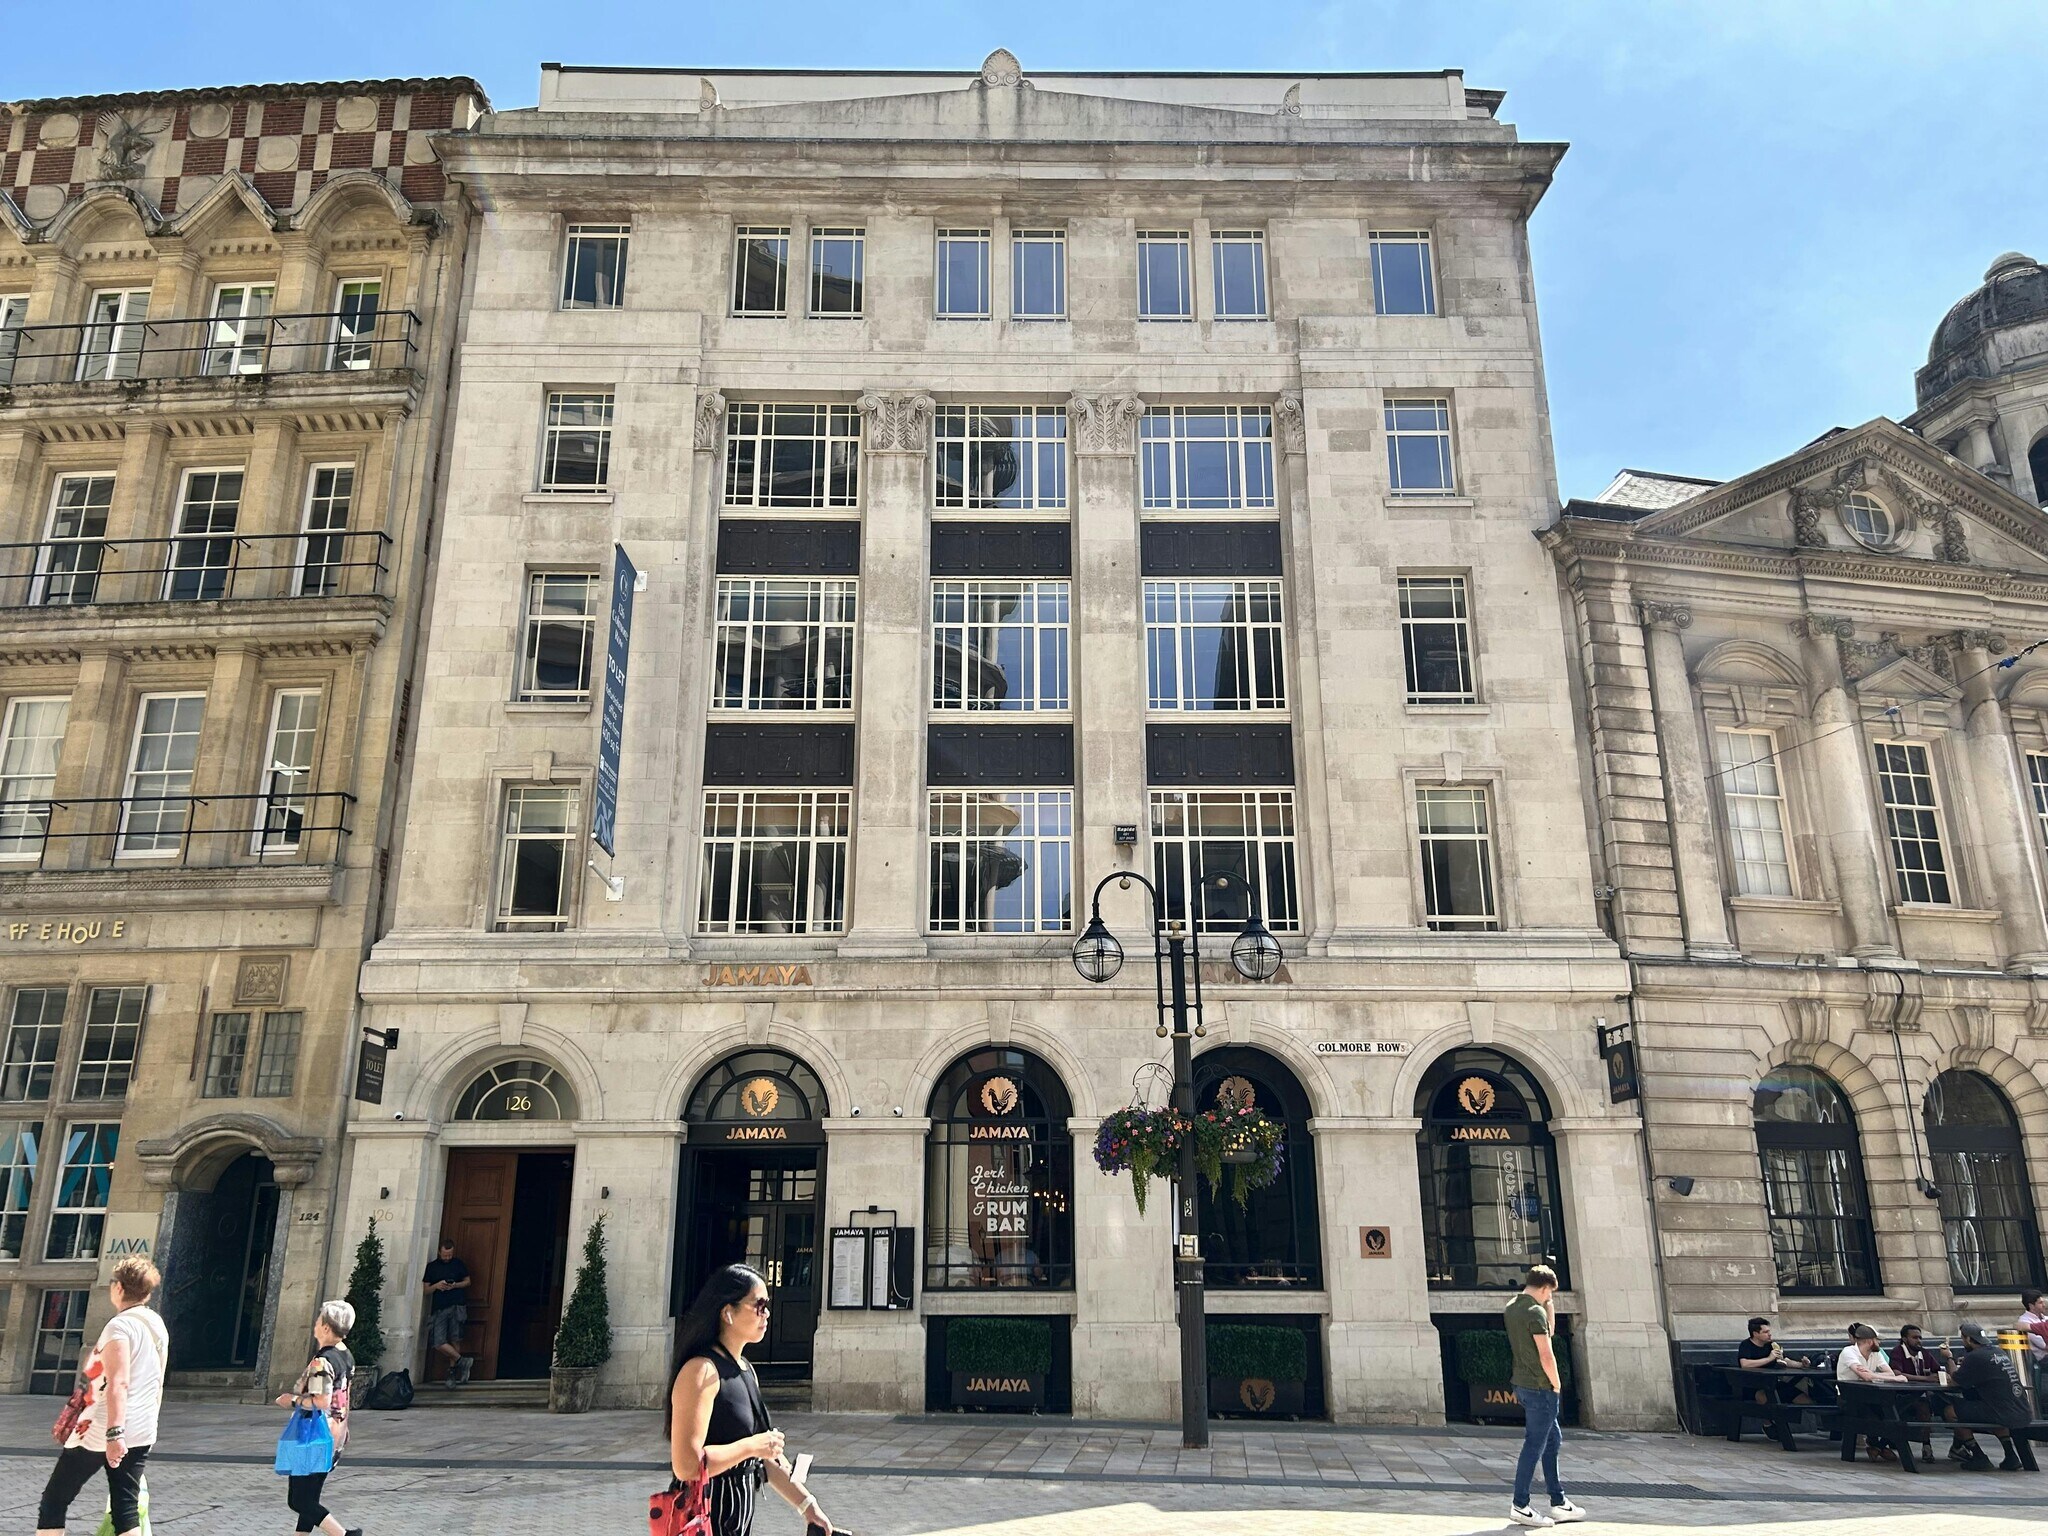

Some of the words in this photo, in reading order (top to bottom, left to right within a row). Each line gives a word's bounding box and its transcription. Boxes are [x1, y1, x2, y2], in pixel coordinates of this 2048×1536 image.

[608, 653, 616, 674] TO
[615, 665, 626, 687] LET
[246, 965, 280, 978] ANNO
[701, 964, 813, 986] JAMAYA
[1317, 1043, 1371, 1052] COLMORE
[1377, 1043, 1400, 1052] ROW
[366, 1059, 374, 1071] TO
[373, 1061, 384, 1074] LET
[505, 1096, 532, 1111] 126
[726, 1127, 787, 1139] JAMAYA
[970, 1126, 1030, 1139] JAMAYA
[1450, 1127, 1511, 1140] JAMAYA
[970, 1165, 1005, 1185] Jerk
[974, 1181, 1029, 1198] Chicken
[987, 1201, 1028, 1216] RUM
[1502, 1150, 1522, 1255] COCKTAILS
[299, 1212, 320, 1221] 124
[373, 1208, 394, 1222] 126
[987, 1217, 1026, 1232] BAR
[106, 1238, 149, 1254] JAVA
[966, 1378, 1031, 1392] JAMAYA
[1484, 1389, 1520, 1405] JAM
